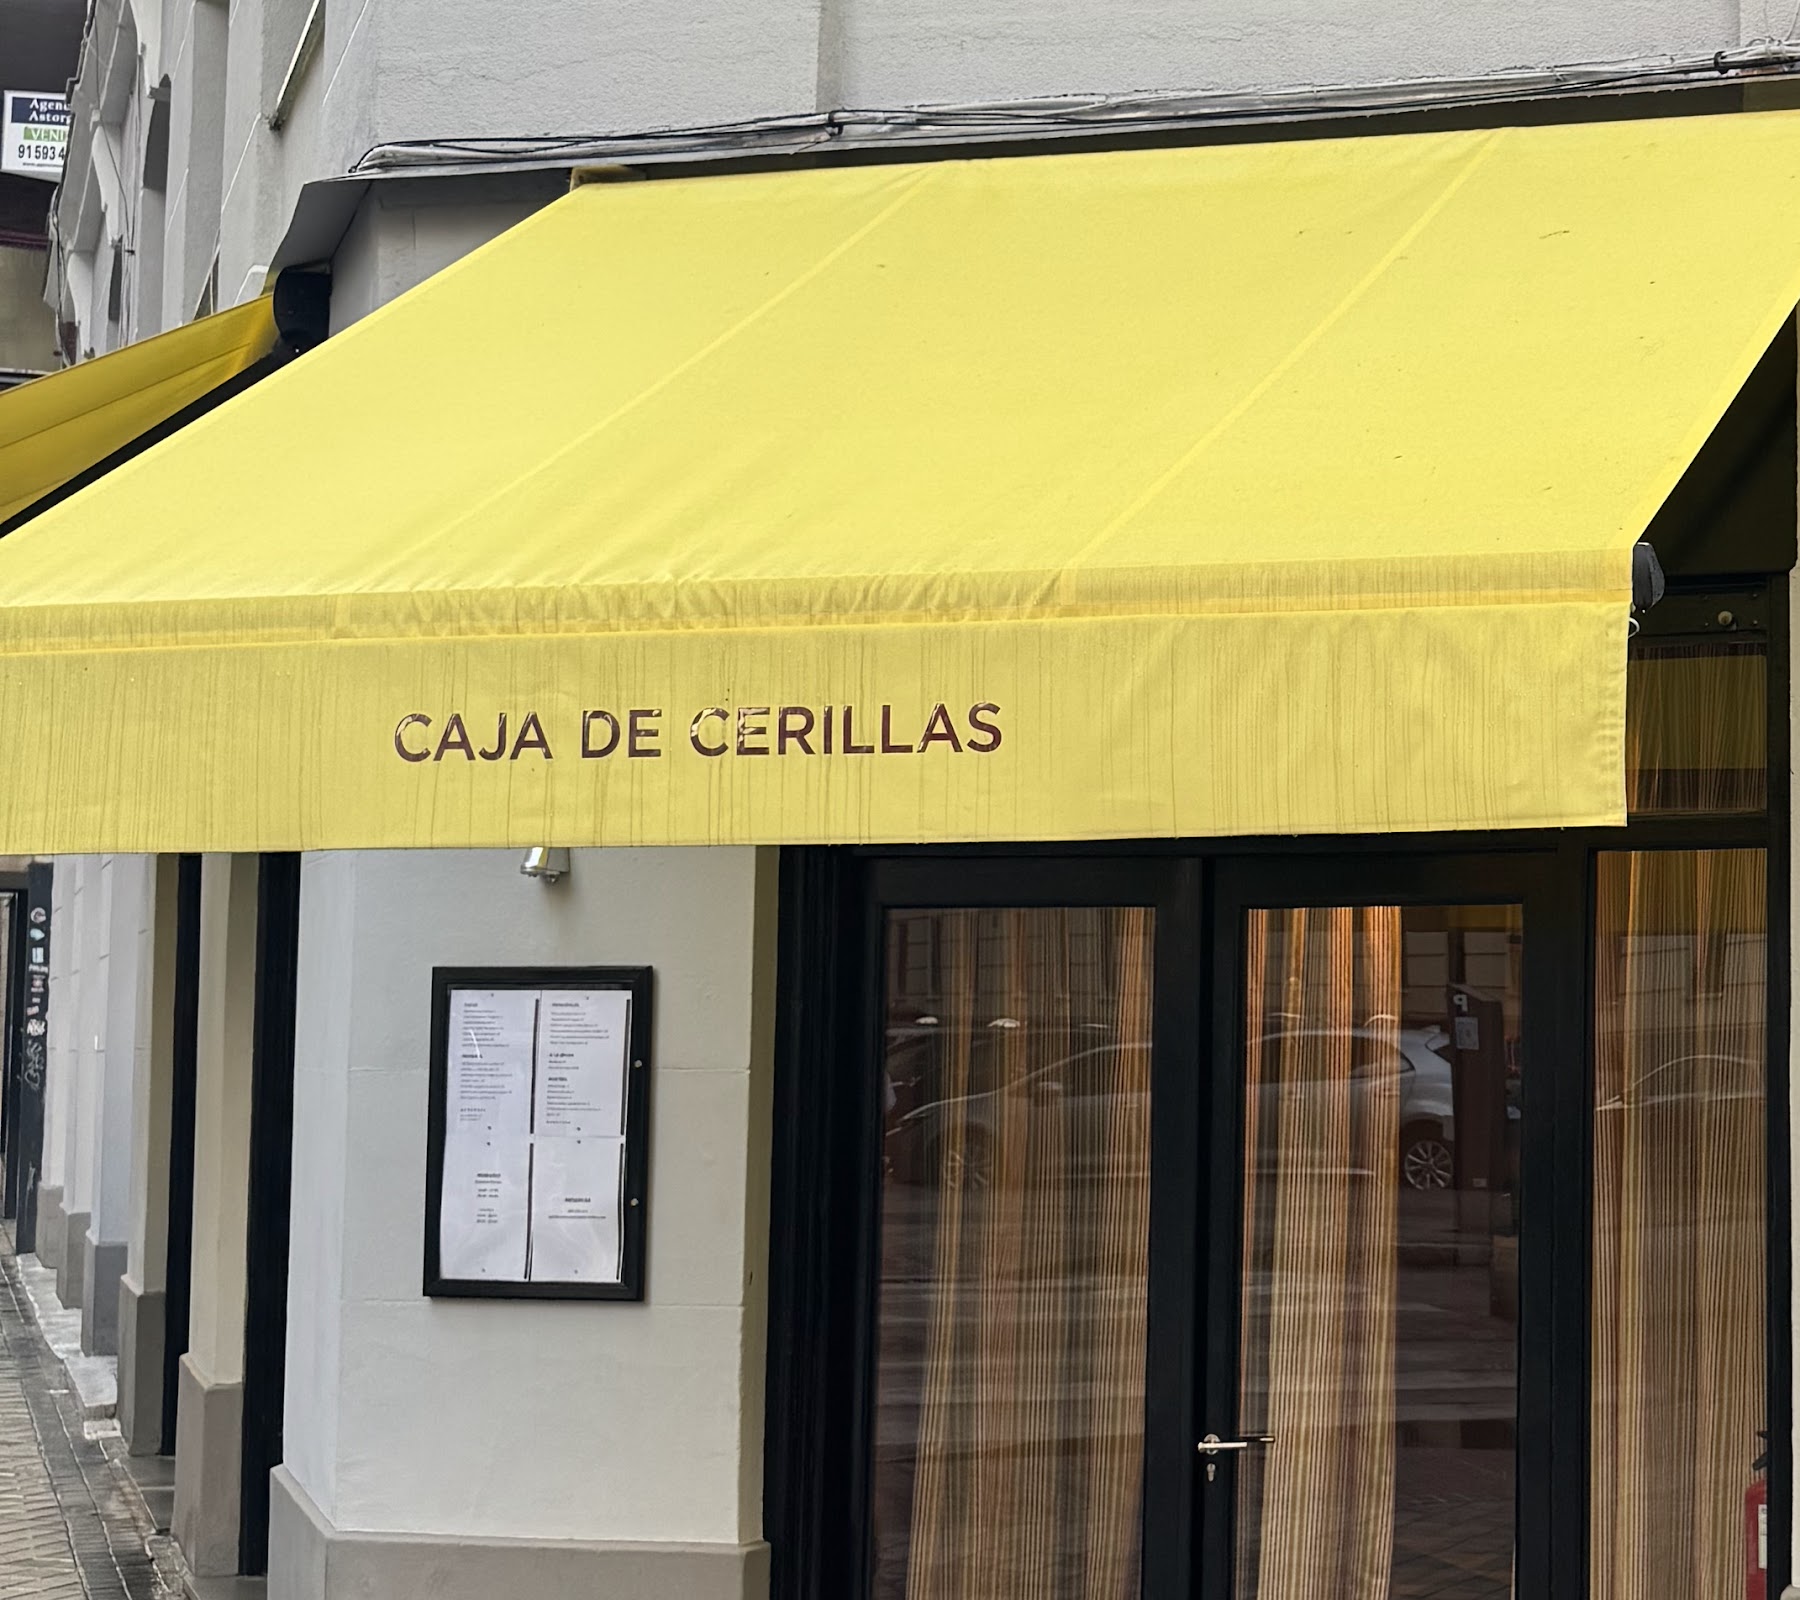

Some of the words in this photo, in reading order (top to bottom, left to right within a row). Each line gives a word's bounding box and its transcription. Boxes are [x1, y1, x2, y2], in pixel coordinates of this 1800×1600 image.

[394, 711, 554, 762] CAJA
[581, 708, 663, 759] DE
[689, 701, 1002, 758] CERILLAS
